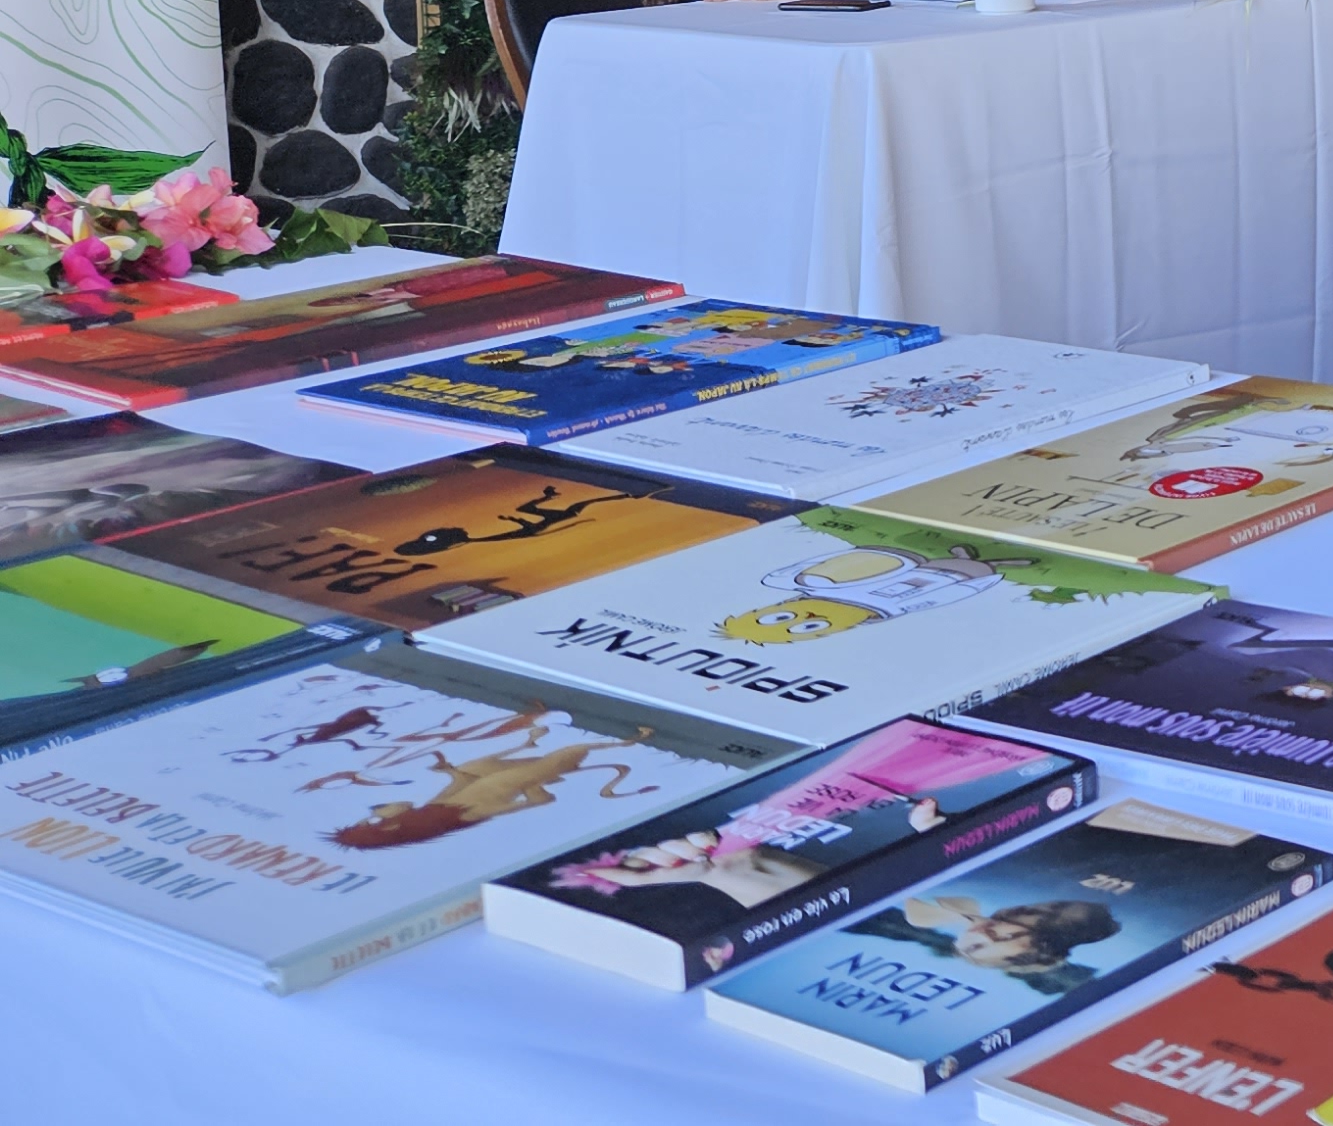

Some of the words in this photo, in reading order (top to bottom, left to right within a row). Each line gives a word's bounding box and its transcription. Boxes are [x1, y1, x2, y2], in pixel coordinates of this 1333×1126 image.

[963, 484, 1119, 519] LAPIN
[1102, 507, 1189, 530] DE
[5, 772, 160, 825] BELETTE
[186, 835, 344, 886] RENARD
[312, 873, 378, 894] LE
[828, 886, 851, 907] La
[781, 909, 803, 926] en
[803, 893, 828, 918] vie
[1234, 890, 1281, 927] MARIN
[742, 919, 781, 944] rose
[1182, 913, 1234, 953] LEDUN
[826, 954, 985, 1010] LEDUN
[796, 978, 929, 1026] MARIN
[1109, 1038, 1304, 1117] L'ENFER
